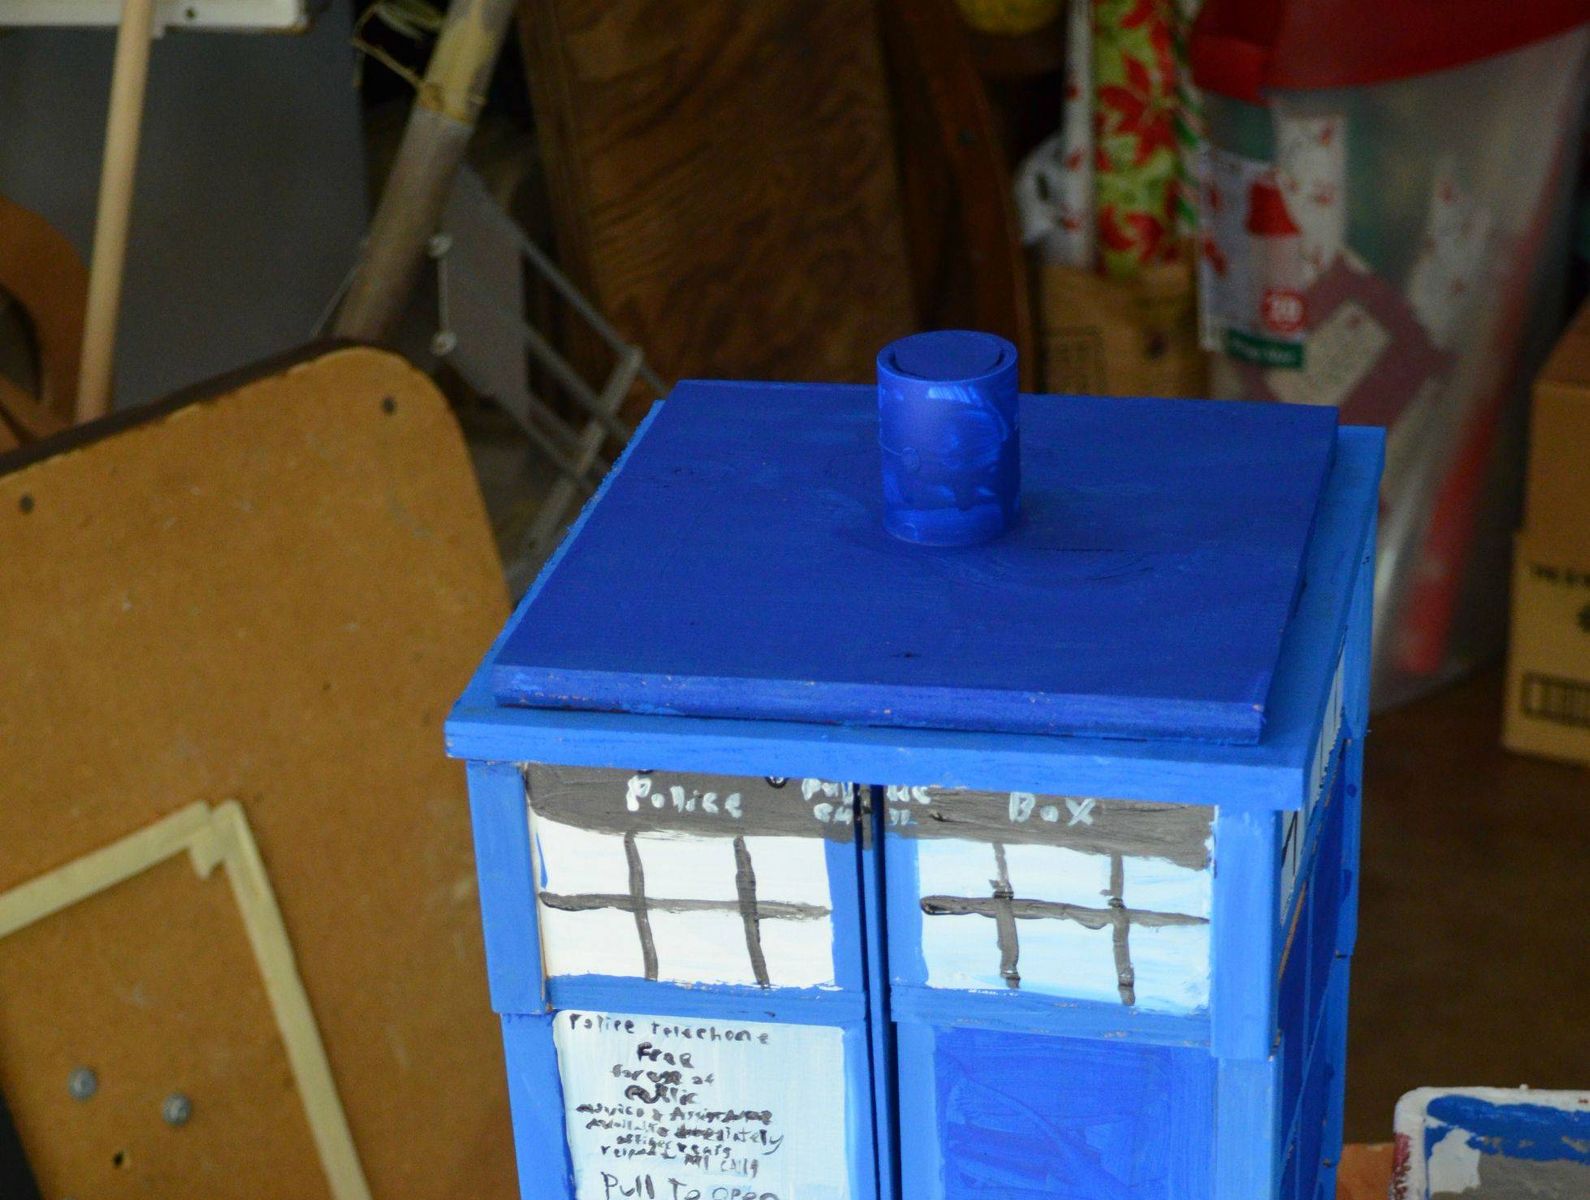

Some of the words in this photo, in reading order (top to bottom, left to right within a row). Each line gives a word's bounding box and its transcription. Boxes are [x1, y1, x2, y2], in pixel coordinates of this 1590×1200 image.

[626, 774, 743, 819] Police
[1009, 792, 1097, 826] Box
[601, 1172, 655, 1200] Pull
